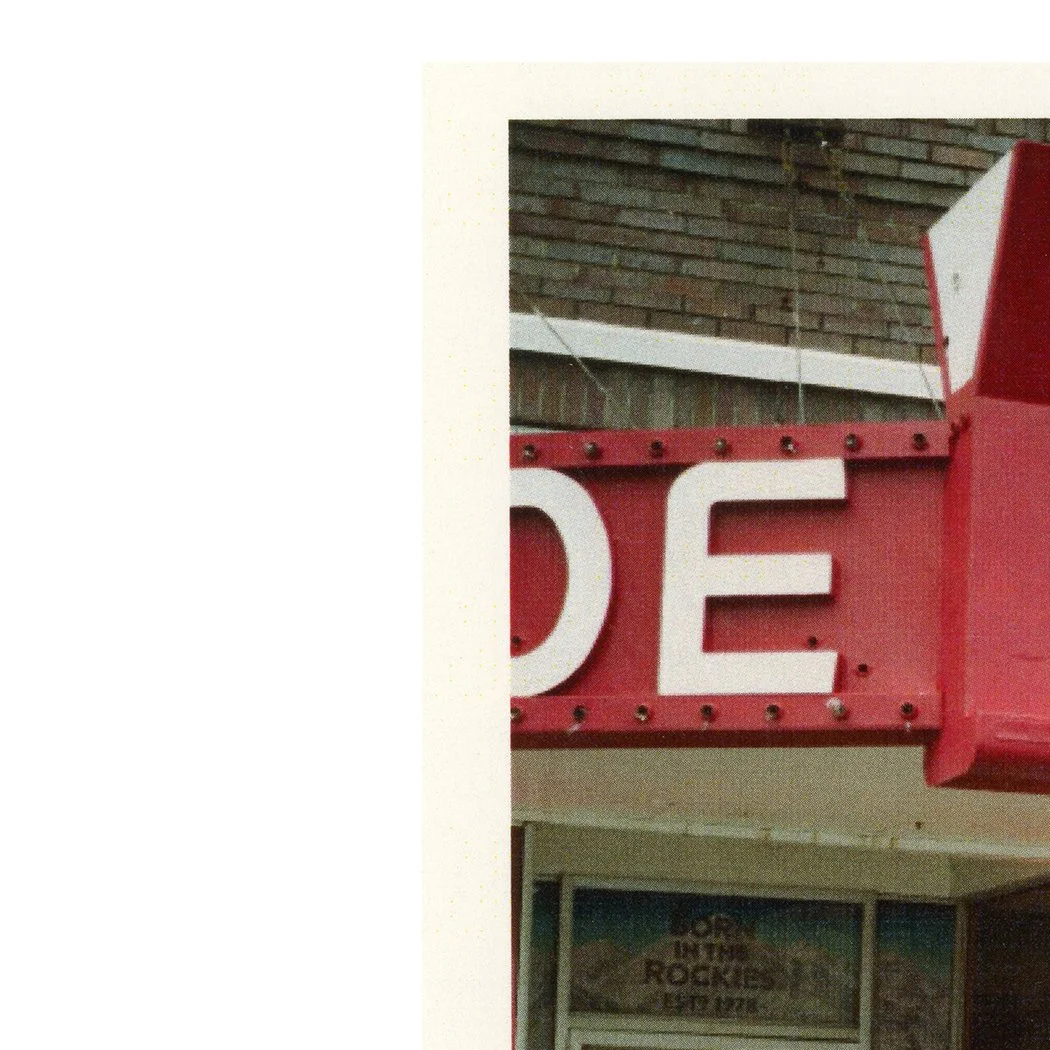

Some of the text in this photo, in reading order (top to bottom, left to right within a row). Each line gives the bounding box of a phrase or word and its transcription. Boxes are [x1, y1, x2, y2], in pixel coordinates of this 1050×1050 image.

[674, 940, 750, 963] IN THE
[644, 958, 776, 991] ROCKIES
